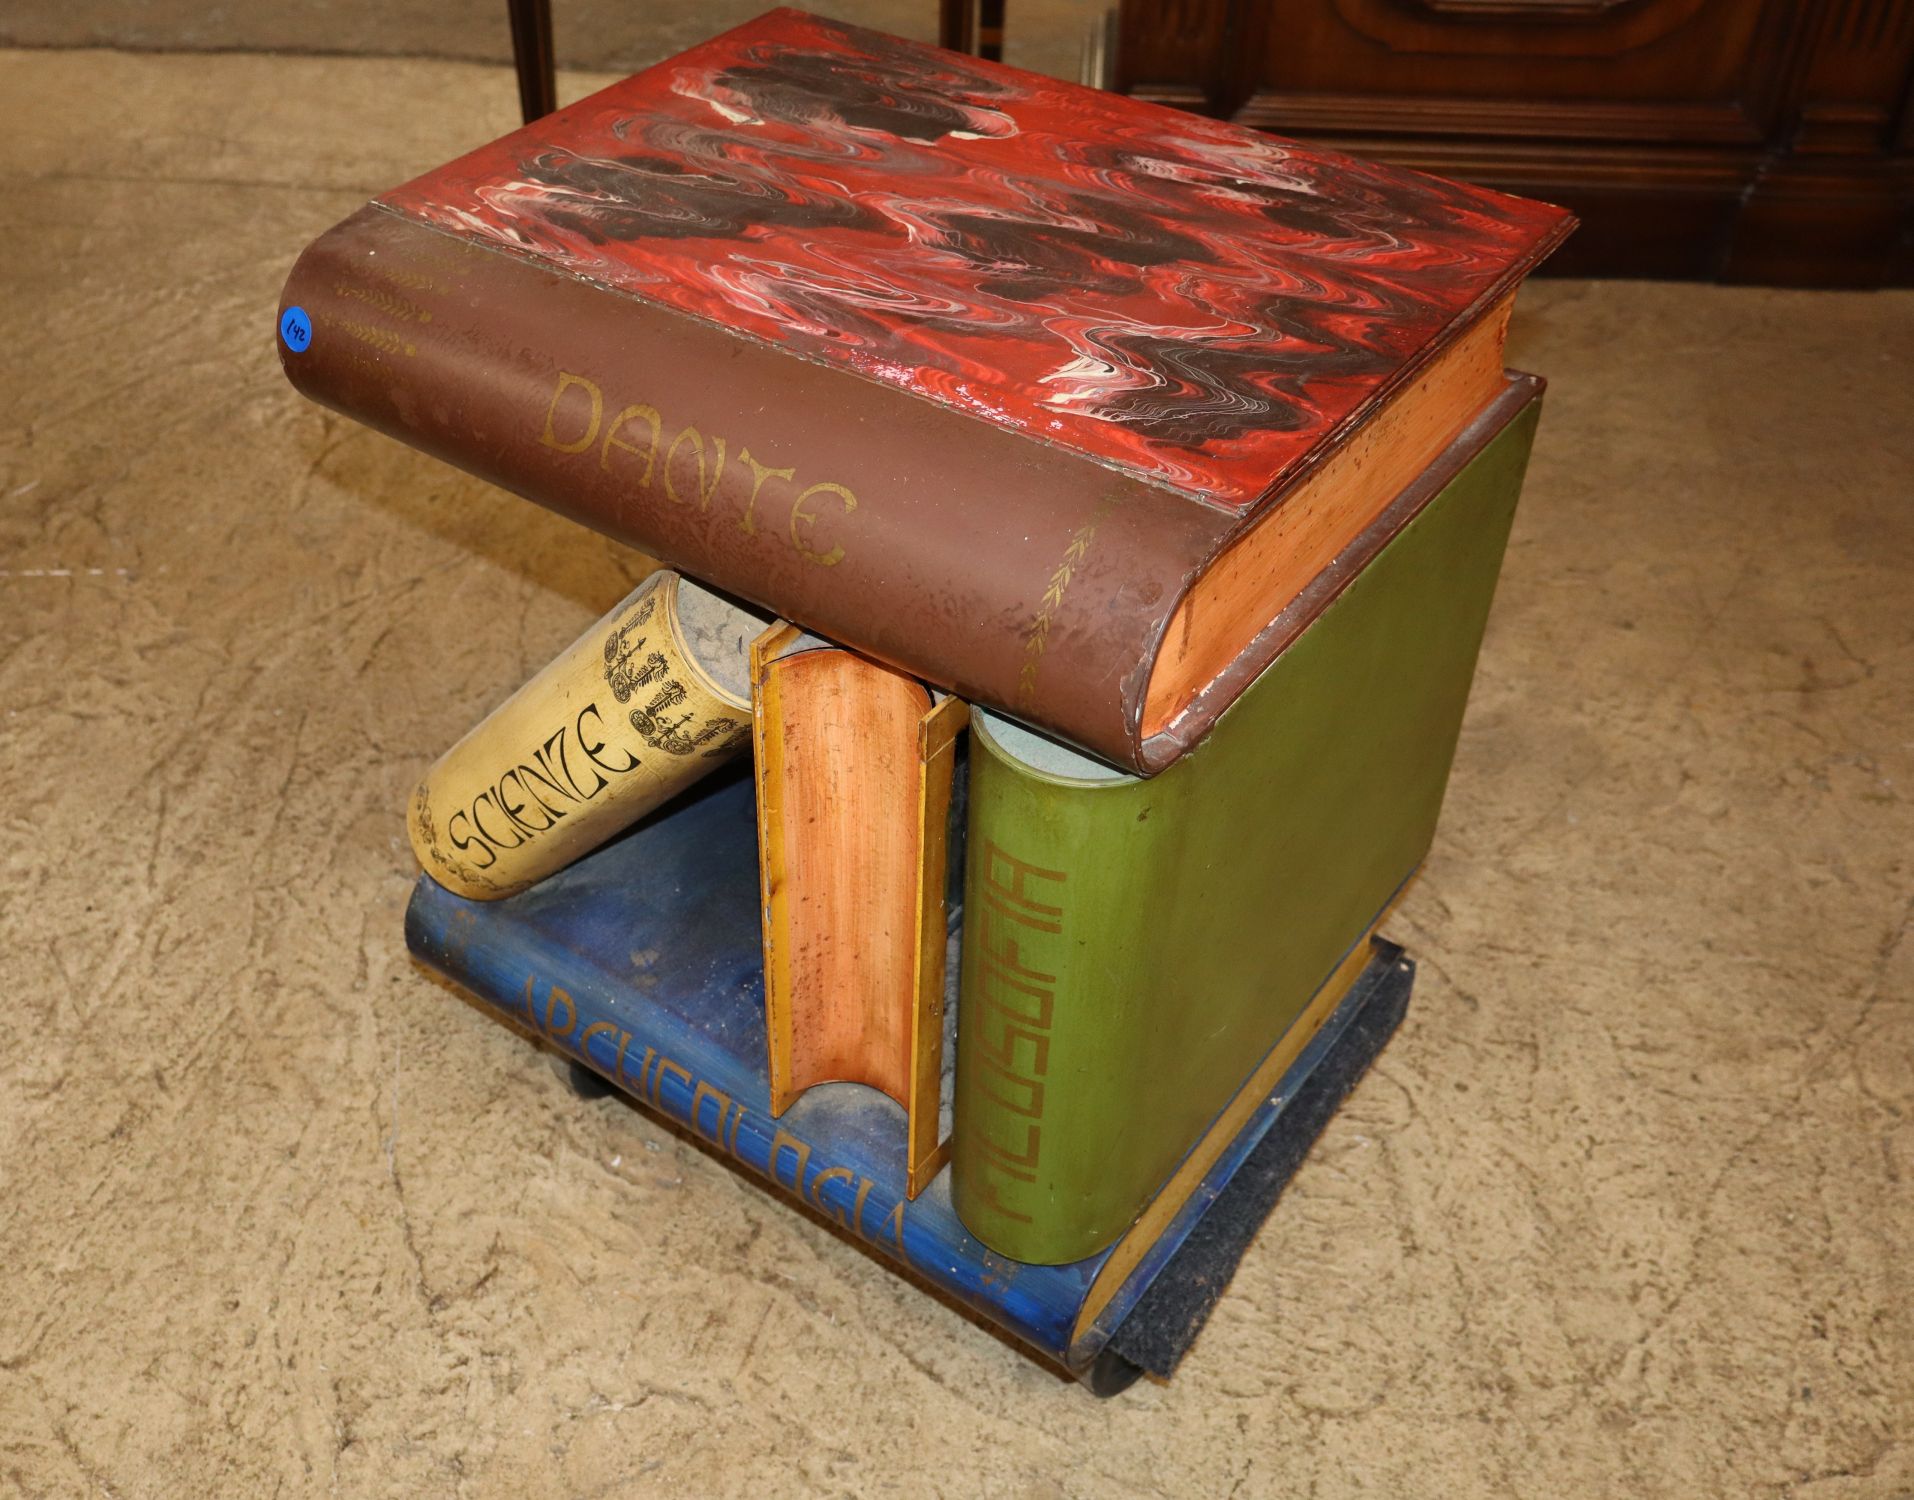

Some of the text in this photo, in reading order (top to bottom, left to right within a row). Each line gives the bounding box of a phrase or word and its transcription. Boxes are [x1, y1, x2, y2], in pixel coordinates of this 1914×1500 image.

[286, 318, 306, 342] 142
[537, 370, 858, 566] DANTE
[448, 702, 642, 870] SCIENZE
[968, 839, 1068, 1226] FILOSOFIA
